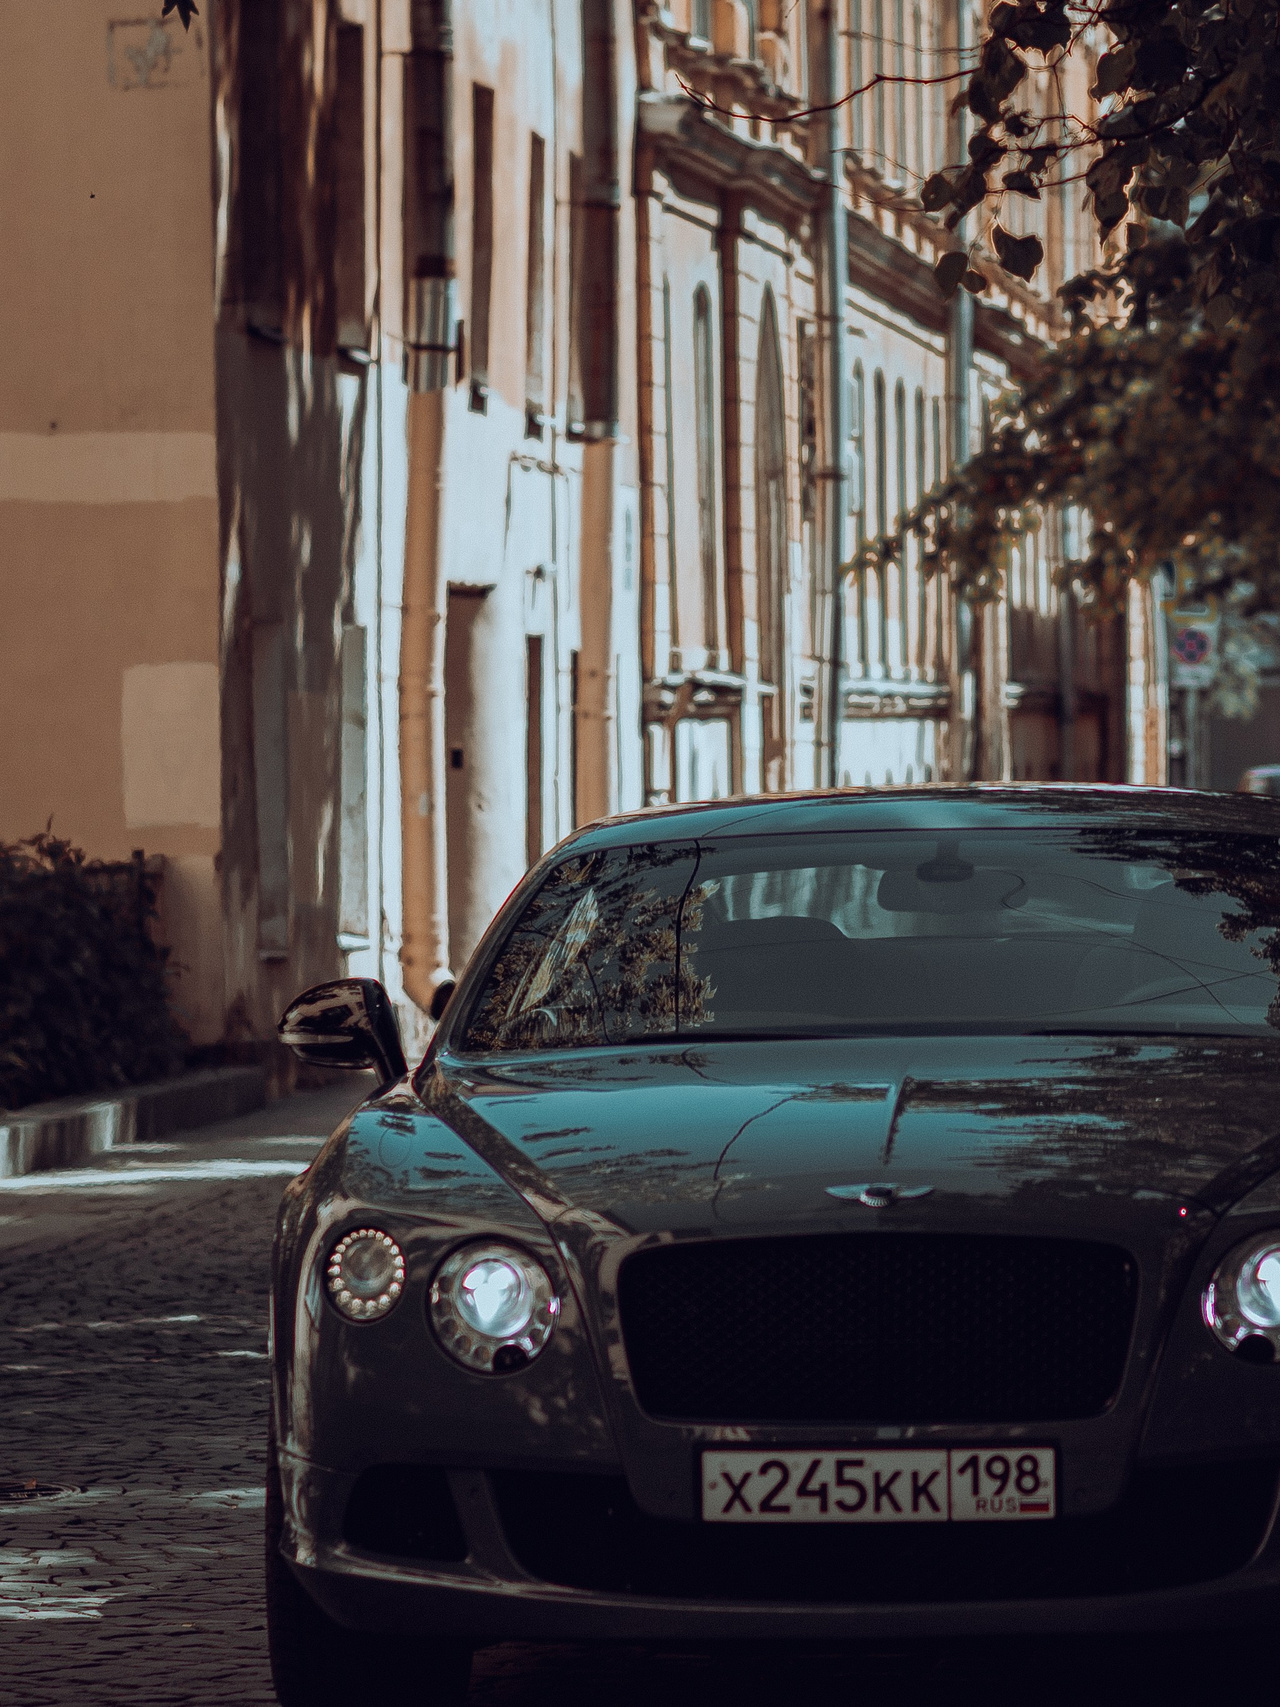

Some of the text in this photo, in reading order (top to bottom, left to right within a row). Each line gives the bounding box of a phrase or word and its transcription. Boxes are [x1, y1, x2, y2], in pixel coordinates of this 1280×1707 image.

[721, 1453, 1041, 1514] Х245КК 198
[975, 1497, 1017, 1514] RUS
